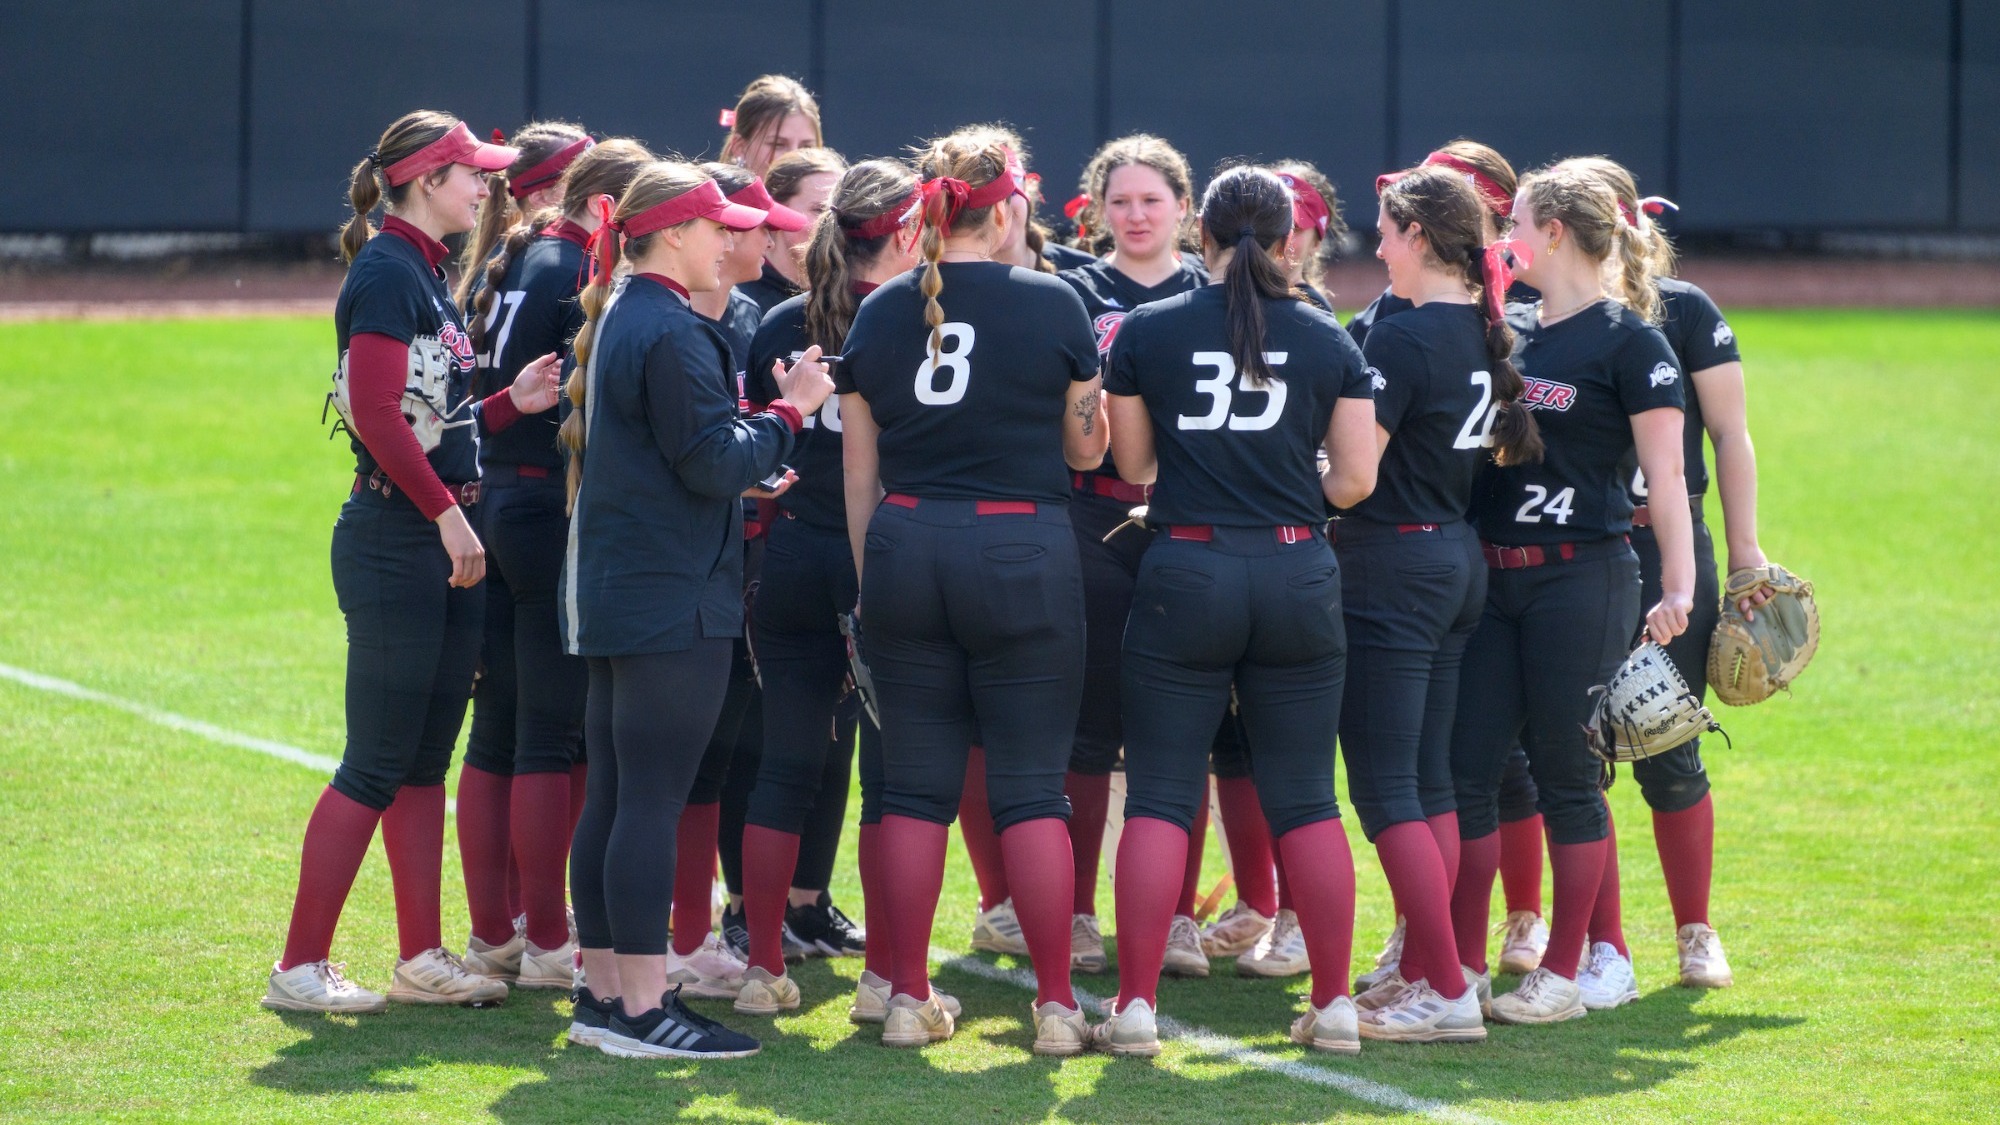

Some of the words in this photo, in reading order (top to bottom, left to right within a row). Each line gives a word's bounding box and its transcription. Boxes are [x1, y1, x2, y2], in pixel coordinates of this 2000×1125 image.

[914, 321, 976, 406] 8
[1177, 351, 1288, 430] 35
[1515, 484, 1576, 525] 24
[1643, 713, 1679, 738] Rawlings
